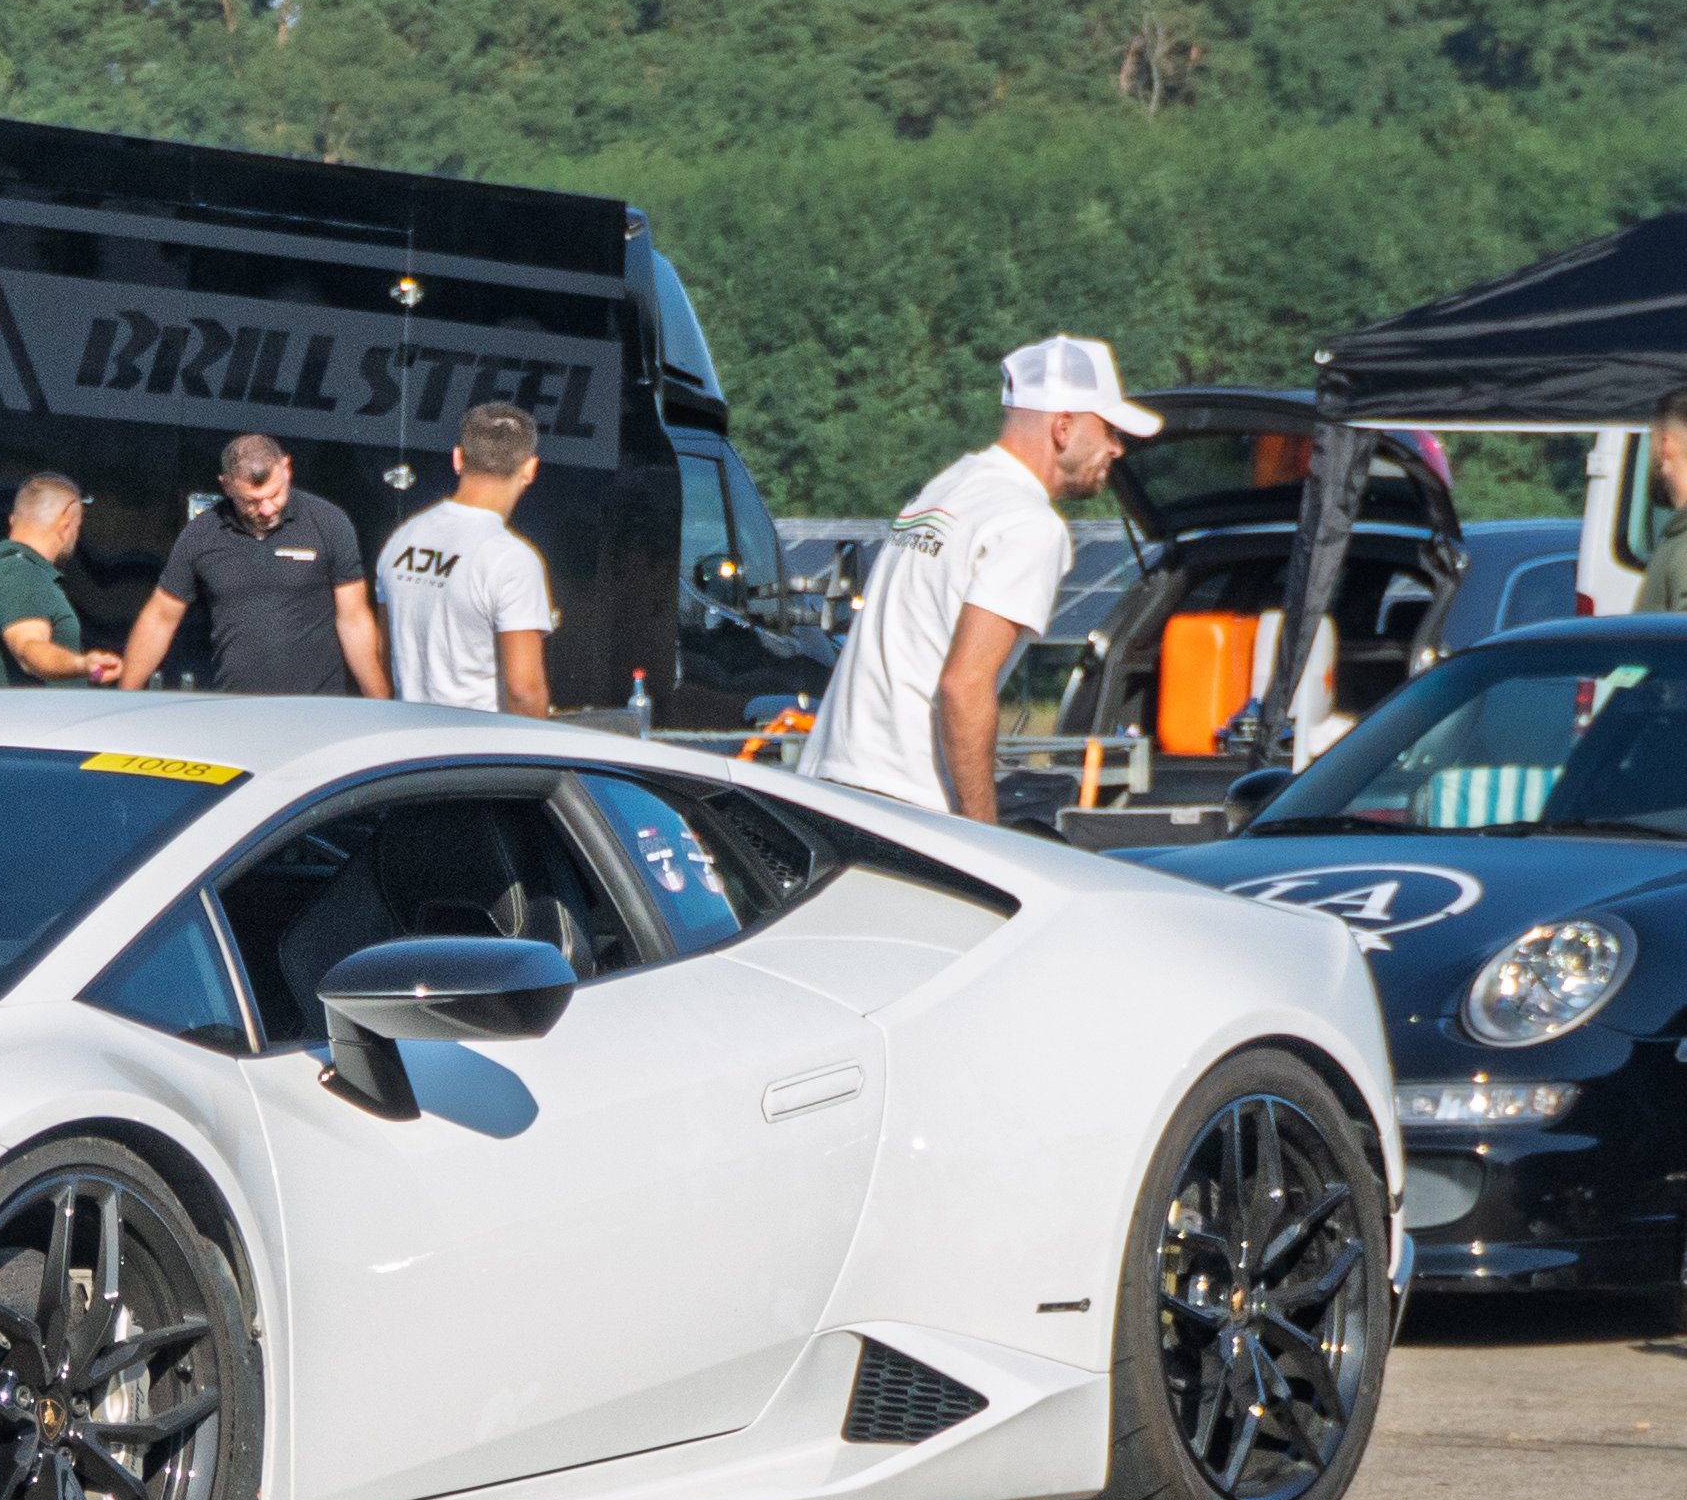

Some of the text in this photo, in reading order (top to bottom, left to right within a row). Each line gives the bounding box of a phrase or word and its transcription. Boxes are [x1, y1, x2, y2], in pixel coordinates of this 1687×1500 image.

[76, 308, 596, 439] BRILL STEEL
[121, 755, 211, 778] 1008
